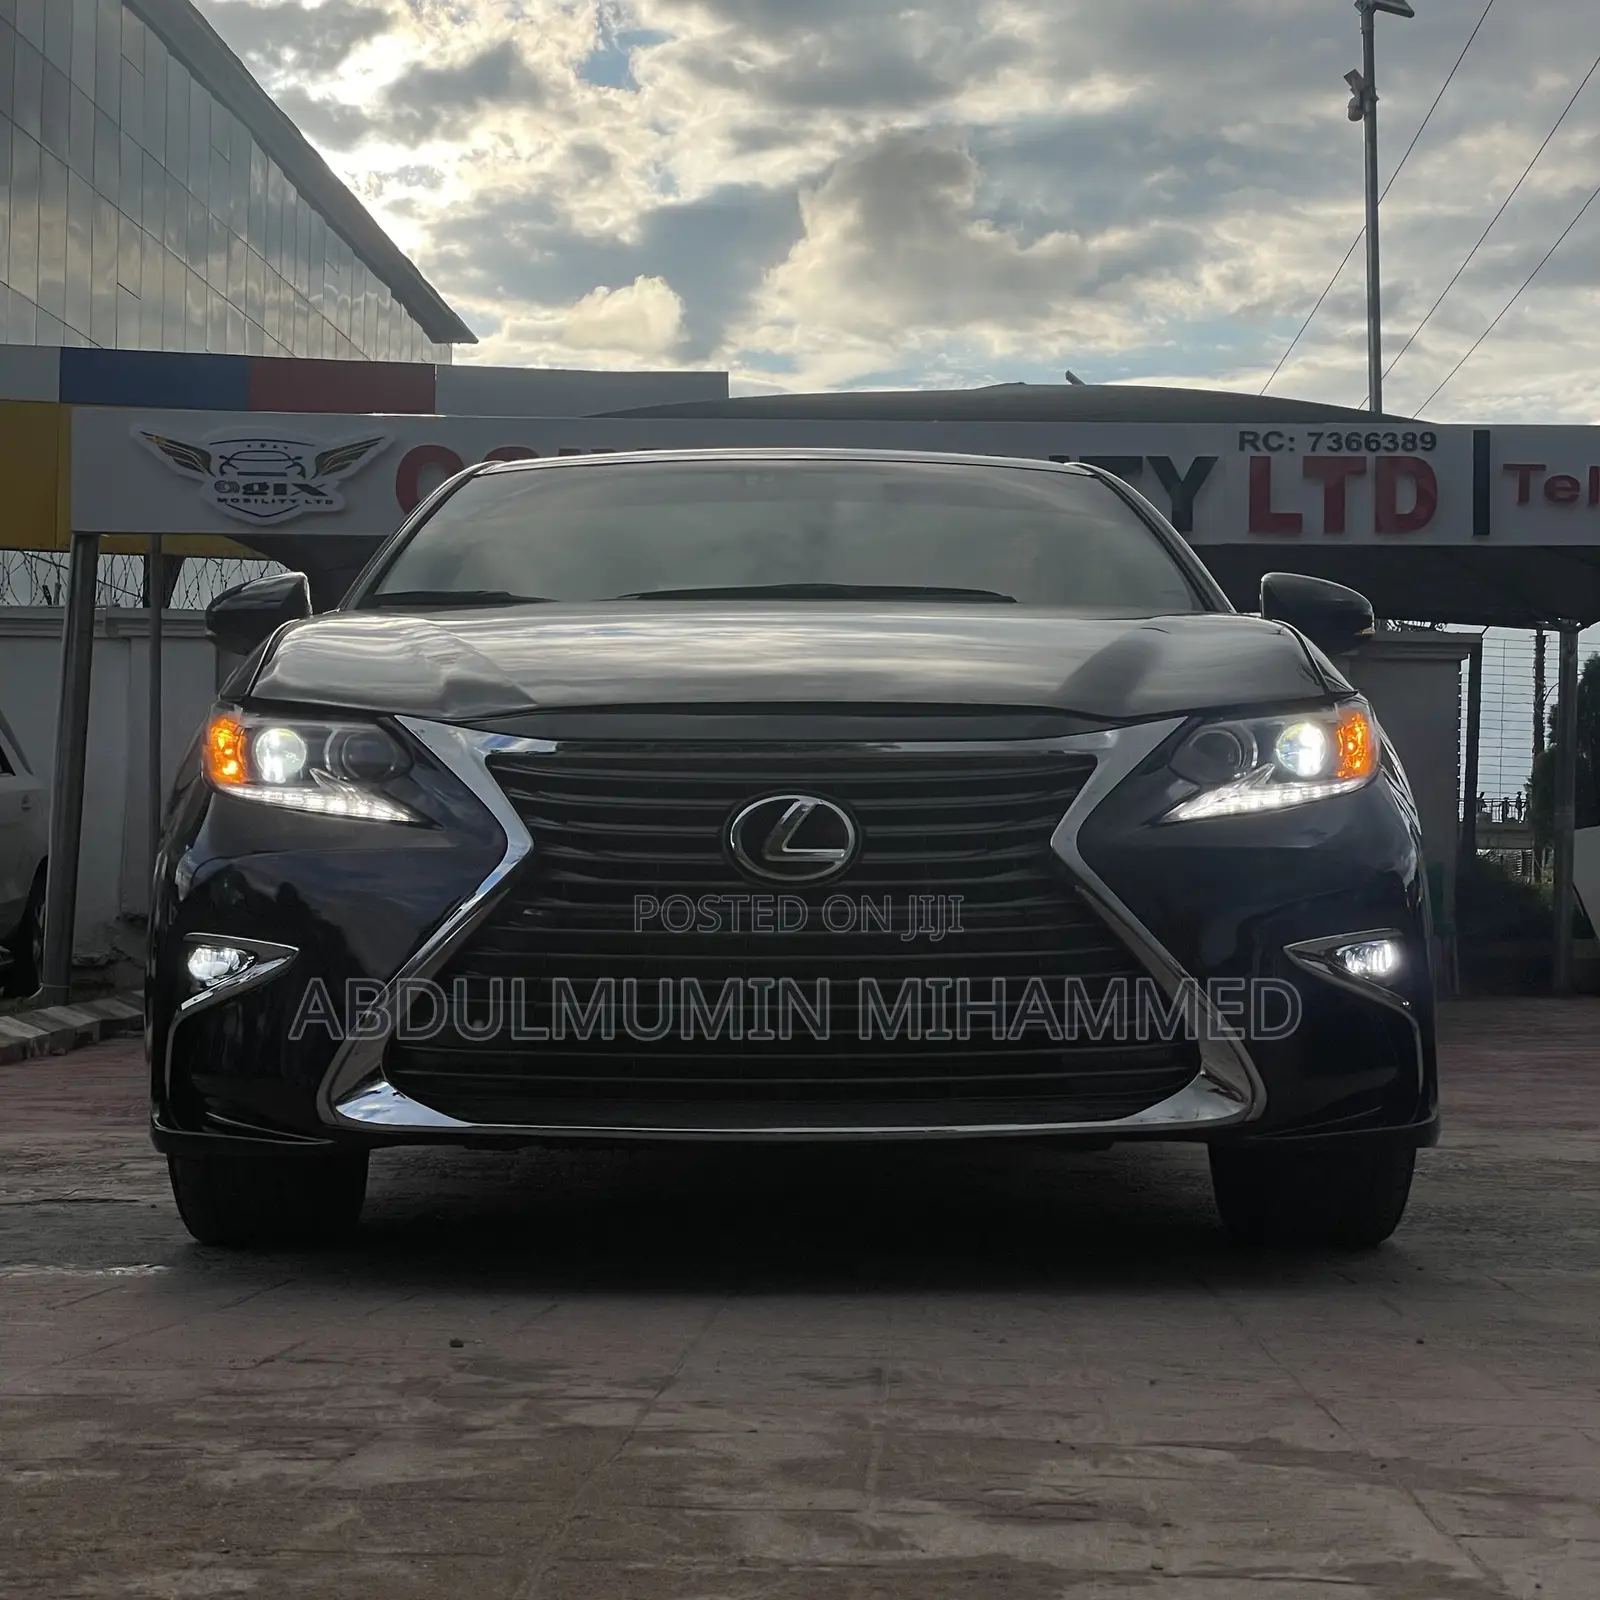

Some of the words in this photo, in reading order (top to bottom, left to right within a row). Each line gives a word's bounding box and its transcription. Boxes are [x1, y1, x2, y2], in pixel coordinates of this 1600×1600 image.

[1238, 431, 1296, 452] RC:
[1307, 431, 1438, 453] 7366389
[216, 497, 298, 505] MOBILITY
[1248, 455, 1439, 534] LTD
